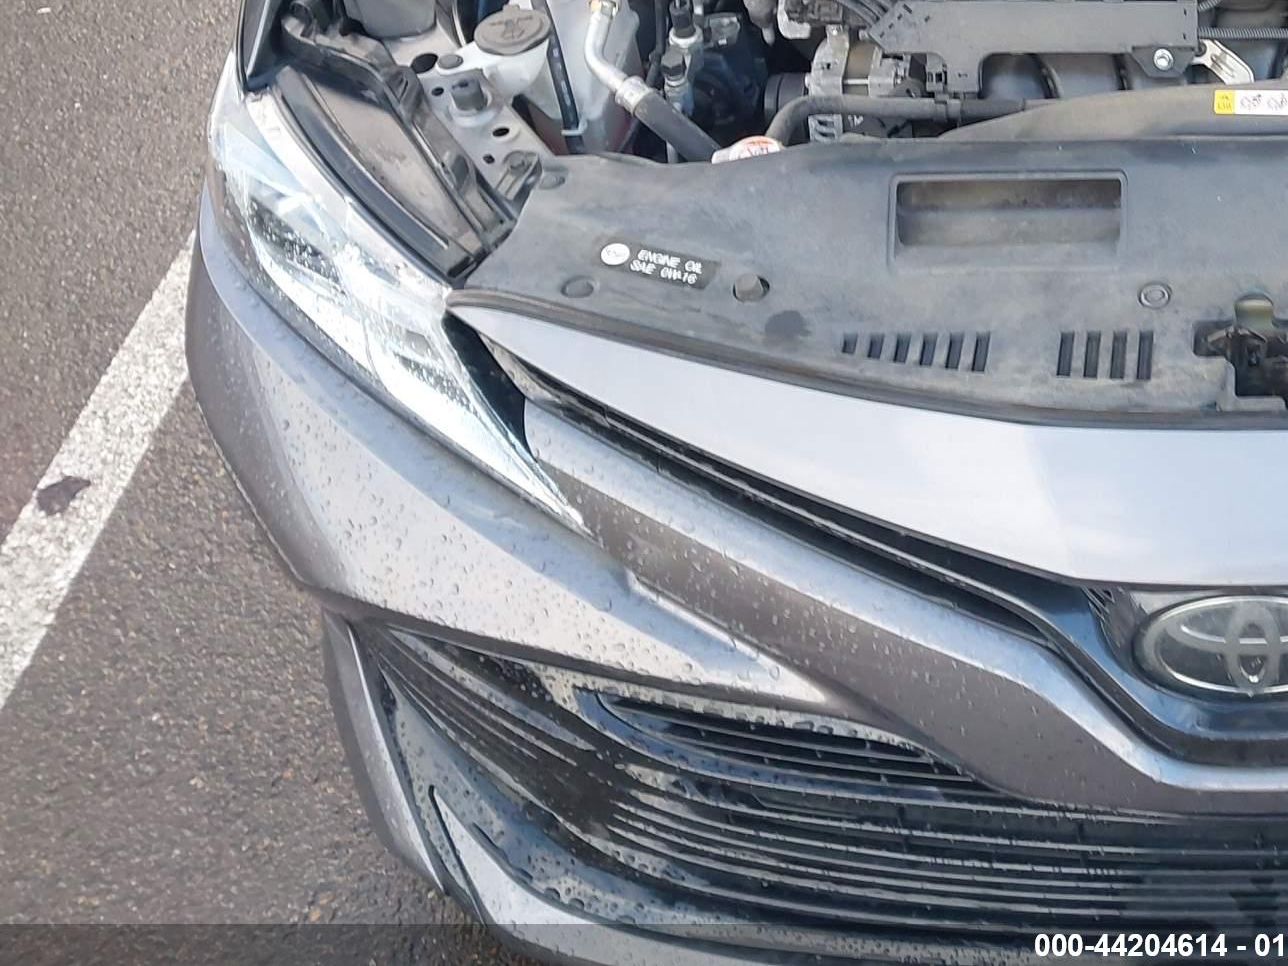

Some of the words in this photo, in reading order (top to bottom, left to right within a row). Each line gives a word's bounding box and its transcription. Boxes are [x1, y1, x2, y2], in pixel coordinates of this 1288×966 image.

[629, 259, 656, 275] SAE
[637, 249, 681, 269] ENGINE
[684, 260, 702, 275] OIL
